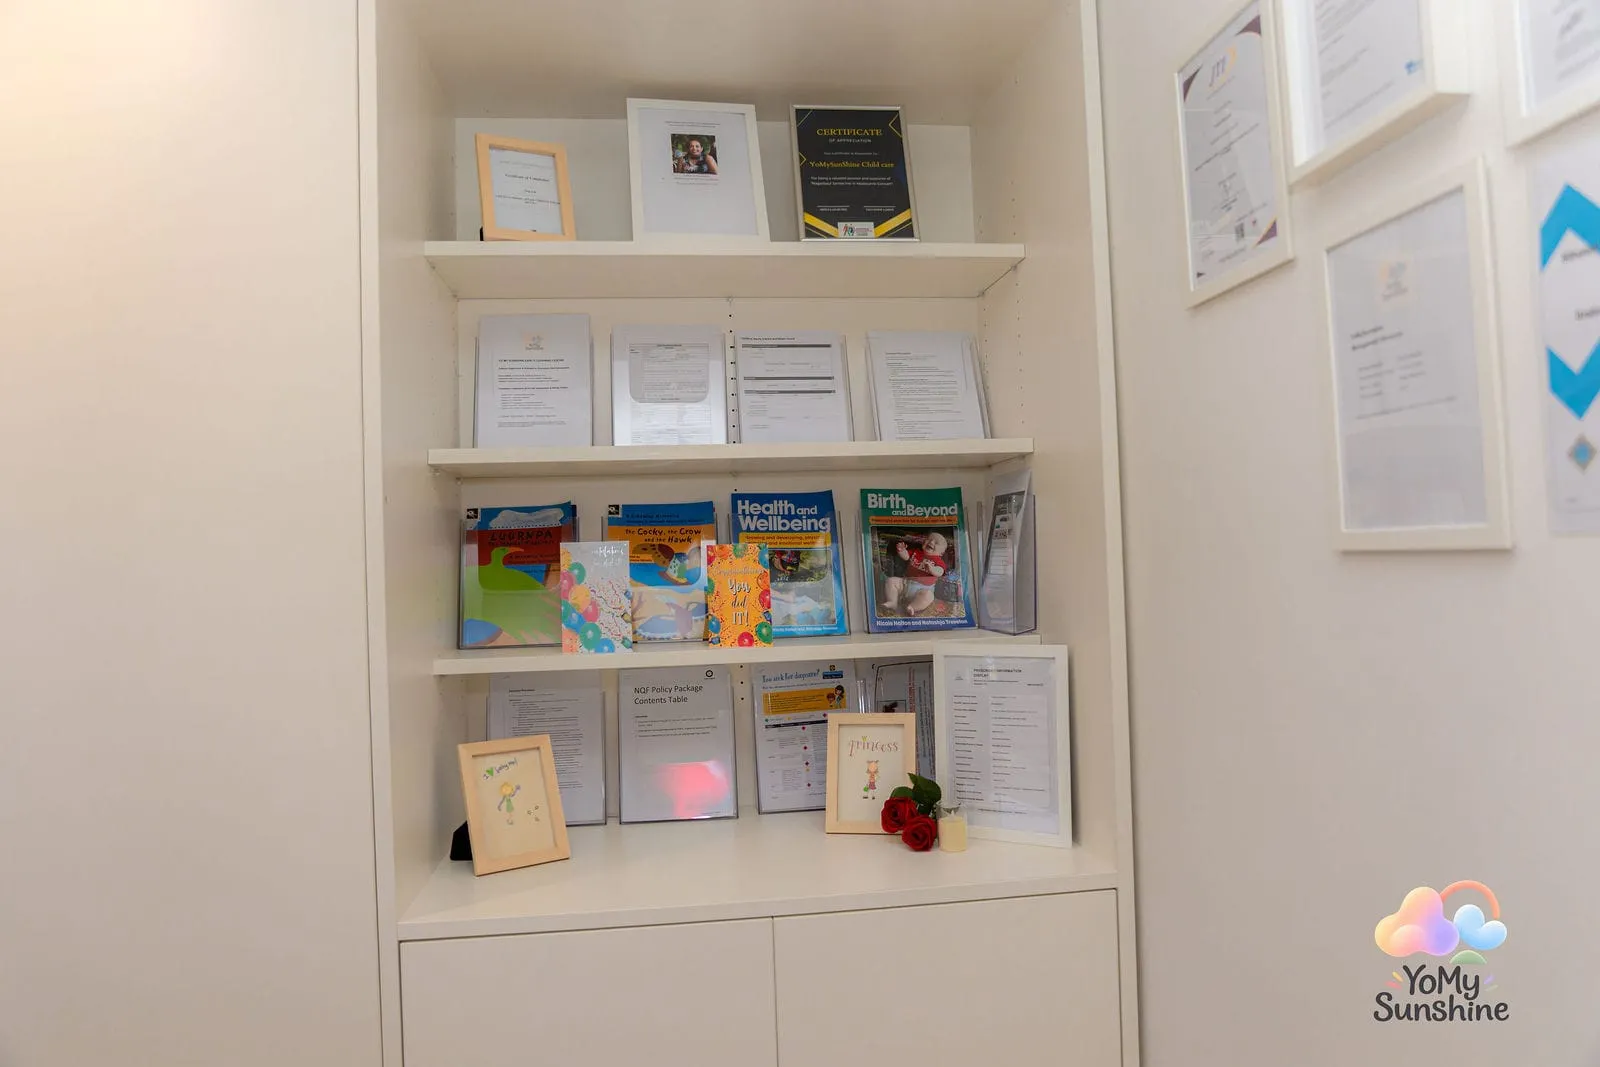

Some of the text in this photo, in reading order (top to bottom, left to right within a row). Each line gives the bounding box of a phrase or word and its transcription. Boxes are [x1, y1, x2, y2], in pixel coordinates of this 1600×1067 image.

[816, 128, 883, 136] CERTIFICATE
[737, 499, 818, 515] Health and
[867, 493, 906, 509] Birth
[892, 503, 958, 518] and Beyond
[738, 515, 831, 533] Wellbeing
[637, 527, 666, 536] Cocky,
[679, 527, 702, 535] Crow
[727, 578, 751, 595] You
[731, 595, 747, 608] did
[732, 611, 749, 625] IT!
[634, 684, 704, 695] NQF Policy Package
[634, 695, 688, 705] Contents Table
[849, 739, 899, 757] princess
